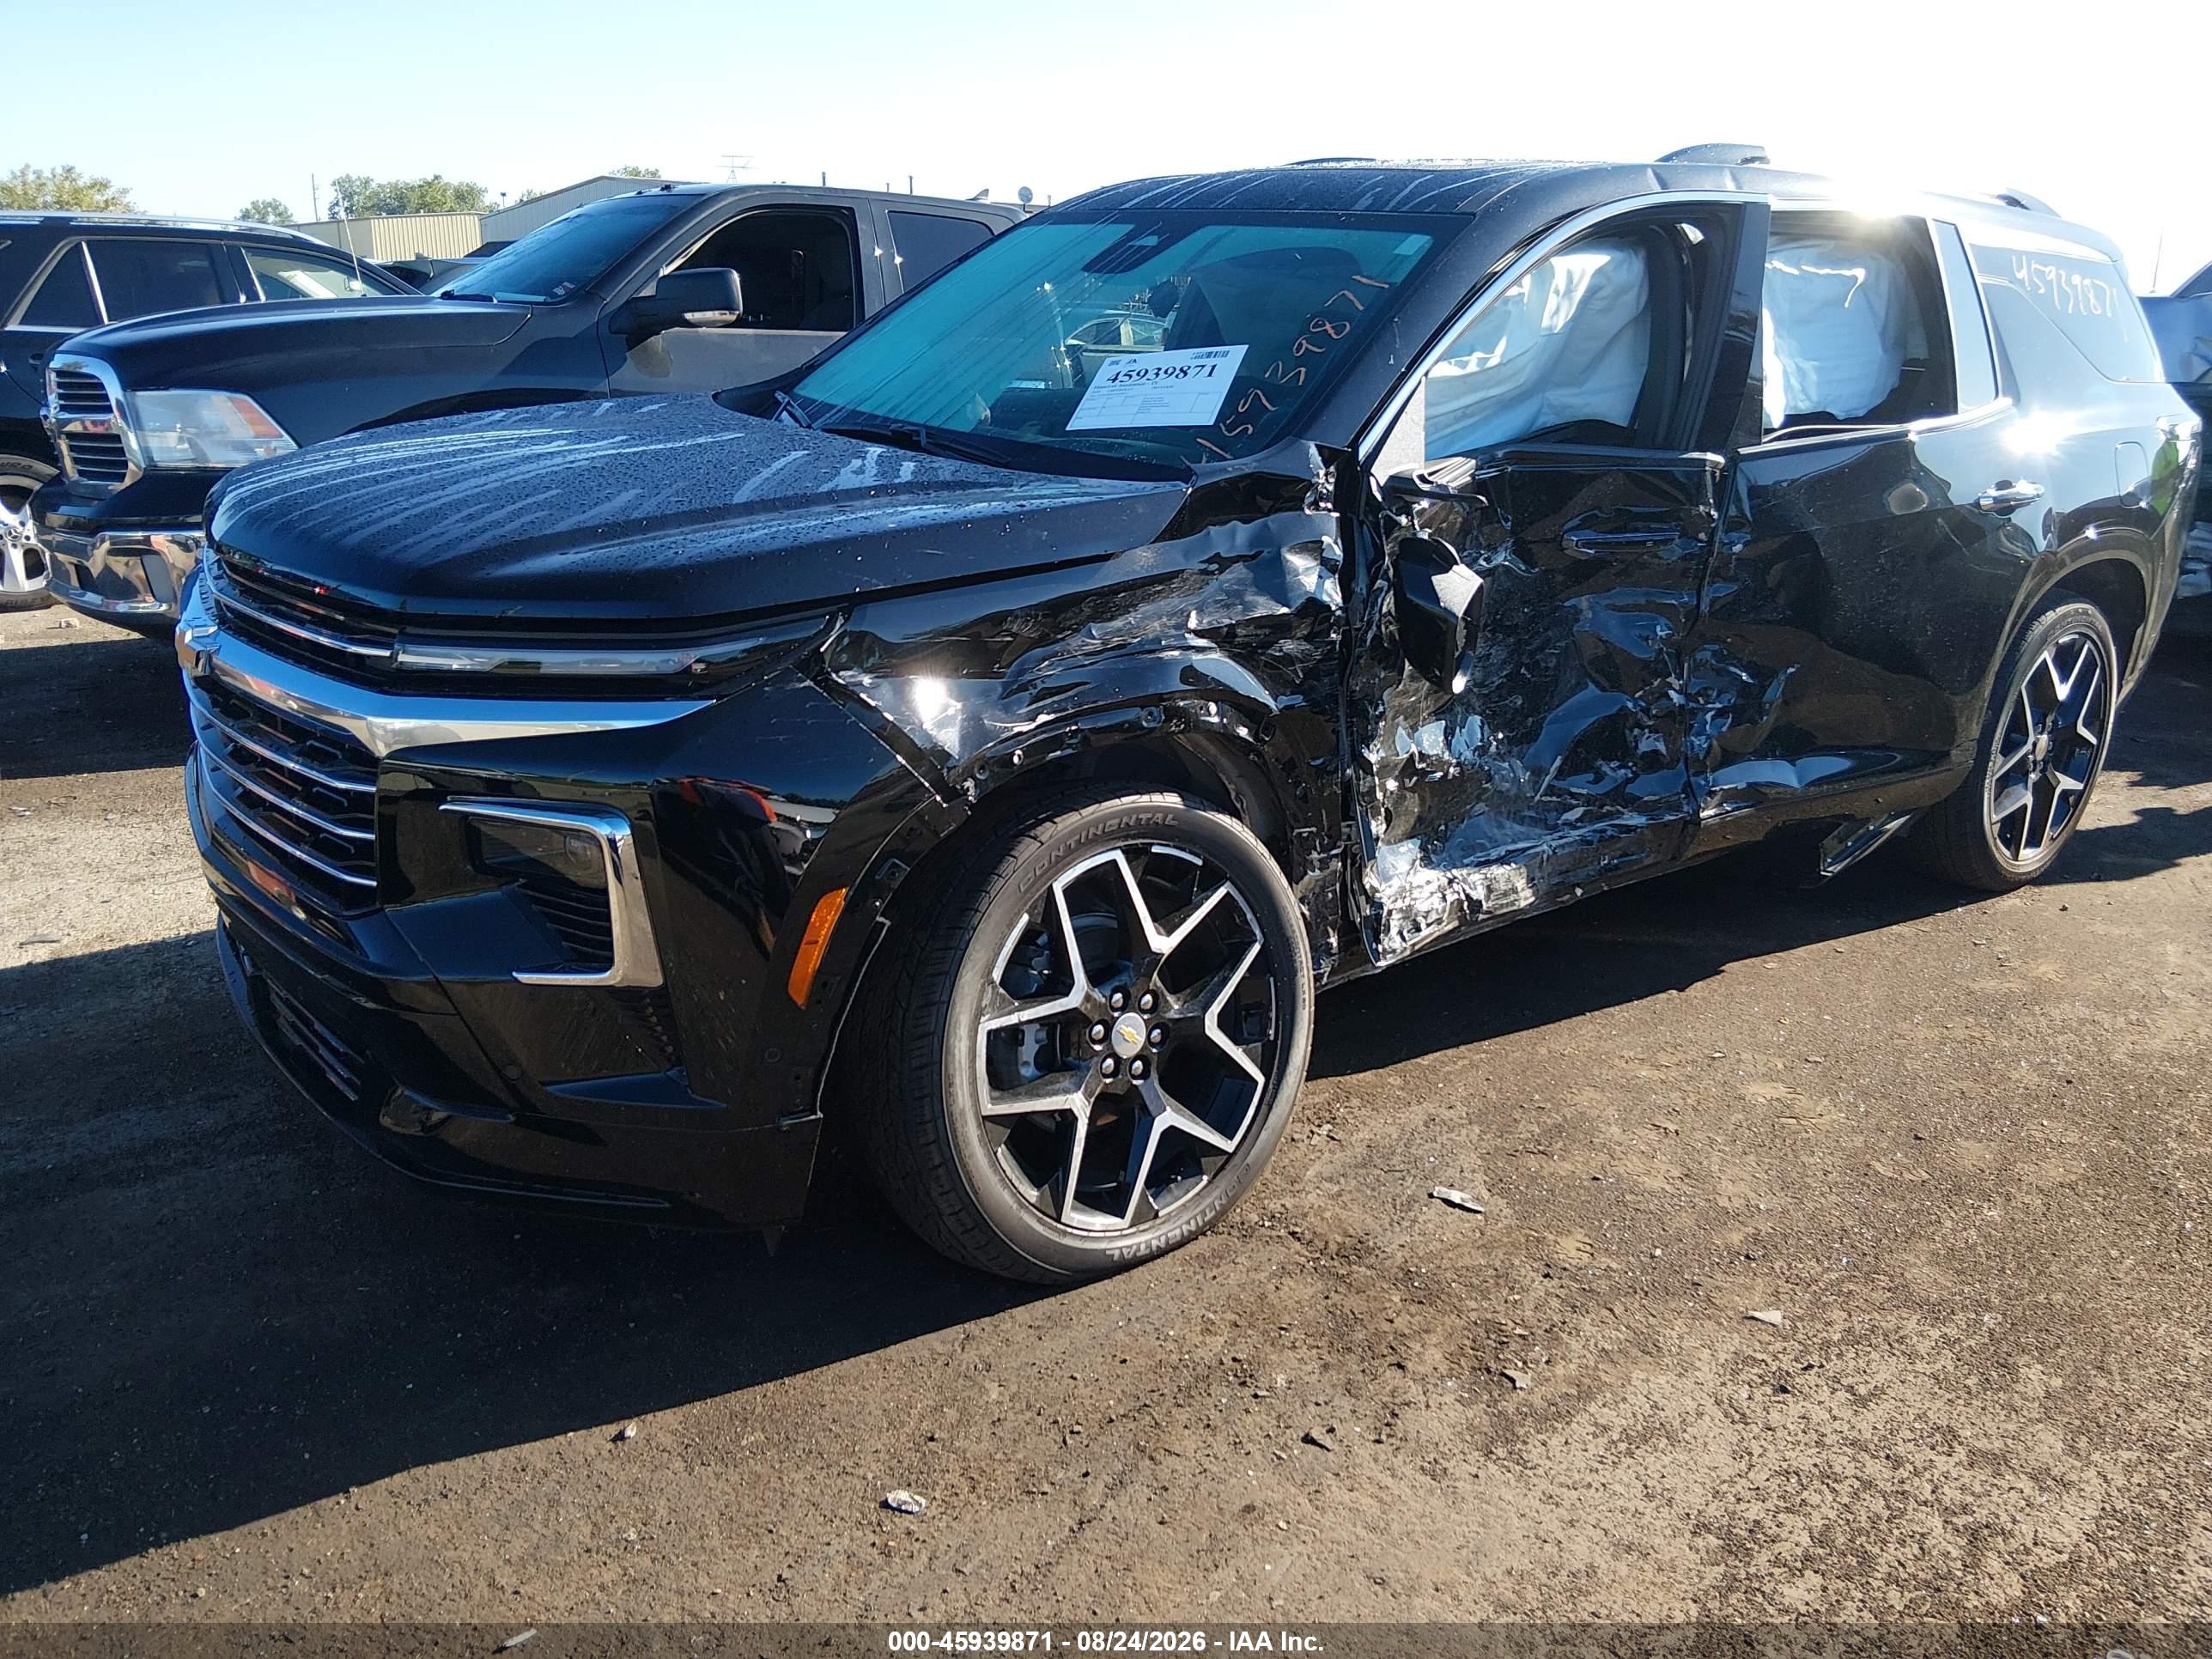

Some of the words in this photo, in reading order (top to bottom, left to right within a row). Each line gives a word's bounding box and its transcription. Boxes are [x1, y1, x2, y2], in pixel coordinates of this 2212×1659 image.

[2012, 255, 2128, 343] 45939871
[1106, 363, 1218, 384] 45939871
[1018, 812, 1180, 894] CONTINENTAL
[1105, 1162, 1252, 1261] CONTINENTAL
